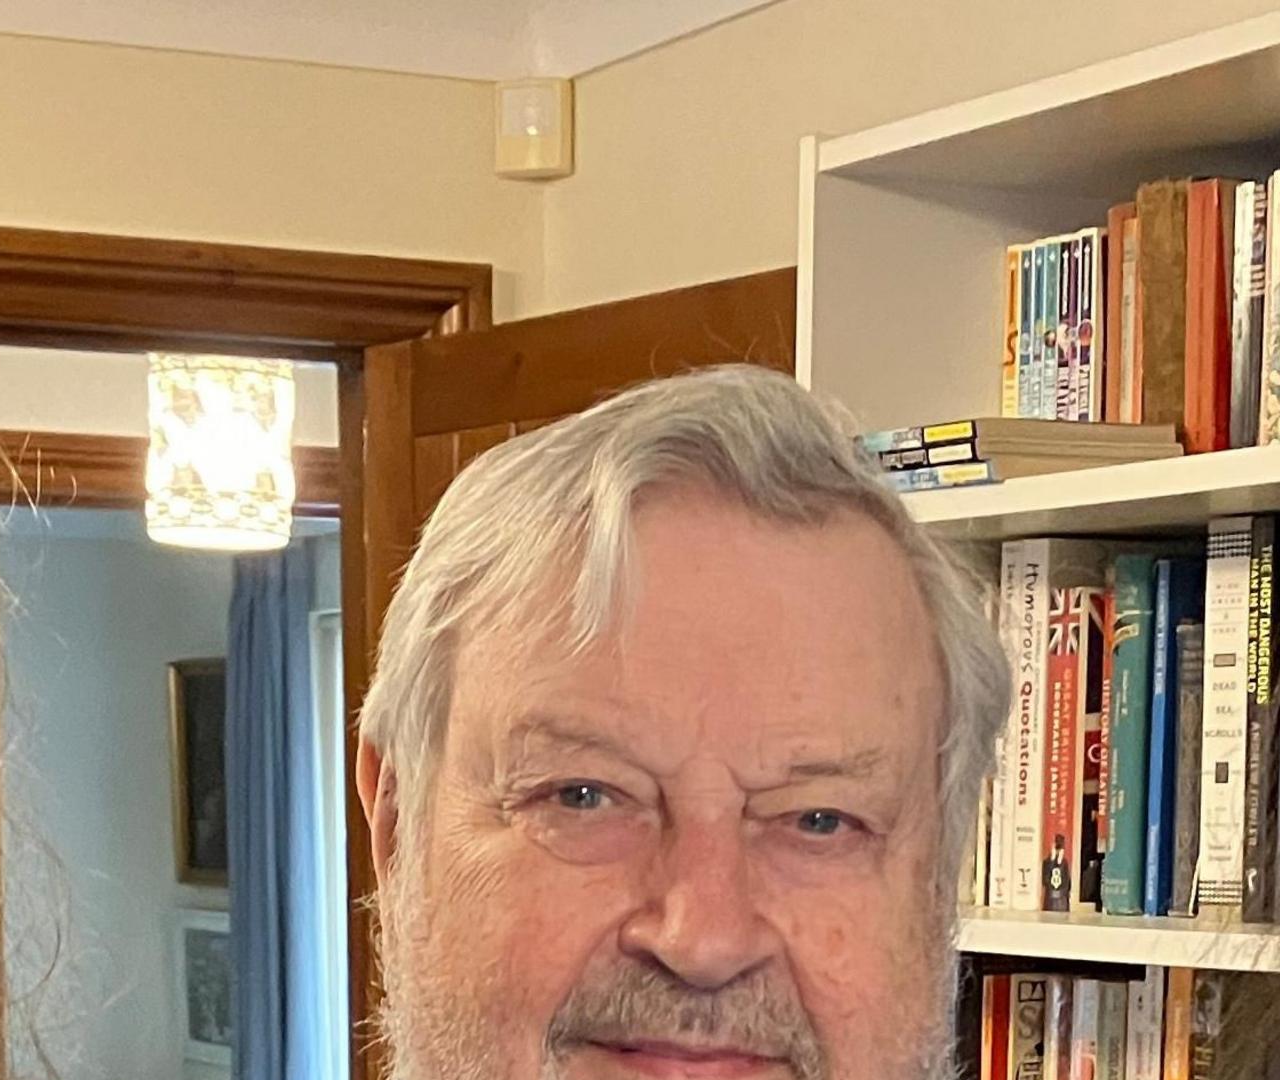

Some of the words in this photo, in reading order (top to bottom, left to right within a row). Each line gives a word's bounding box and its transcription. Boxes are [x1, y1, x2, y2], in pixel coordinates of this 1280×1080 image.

[1249, 557, 1260, 589] MAN
[1258, 544, 1273, 574] THE
[1248, 591, 1259, 607] IN
[1257, 574, 1272, 616] MOST
[1019, 562, 1040, 678] Humorous
[1248, 610, 1259, 639] THE
[1246, 641, 1259, 694] WORLD
[1255, 617, 1272, 705] DANGEROUS
[1061, 667, 1073, 720] GREAT
[1212, 681, 1237, 691] DEAD
[1051, 681, 1062, 763] ROSEMARIE
[1101, 678, 1111, 743] HISTORY
[1204, 728, 1243, 738] SCROLLS
[1215, 705, 1232, 715] SEA
[1016, 681, 1034, 807] Quotations
[1059, 727, 1072, 793] BRITISH
[1097, 770, 1109, 816] LATIN
